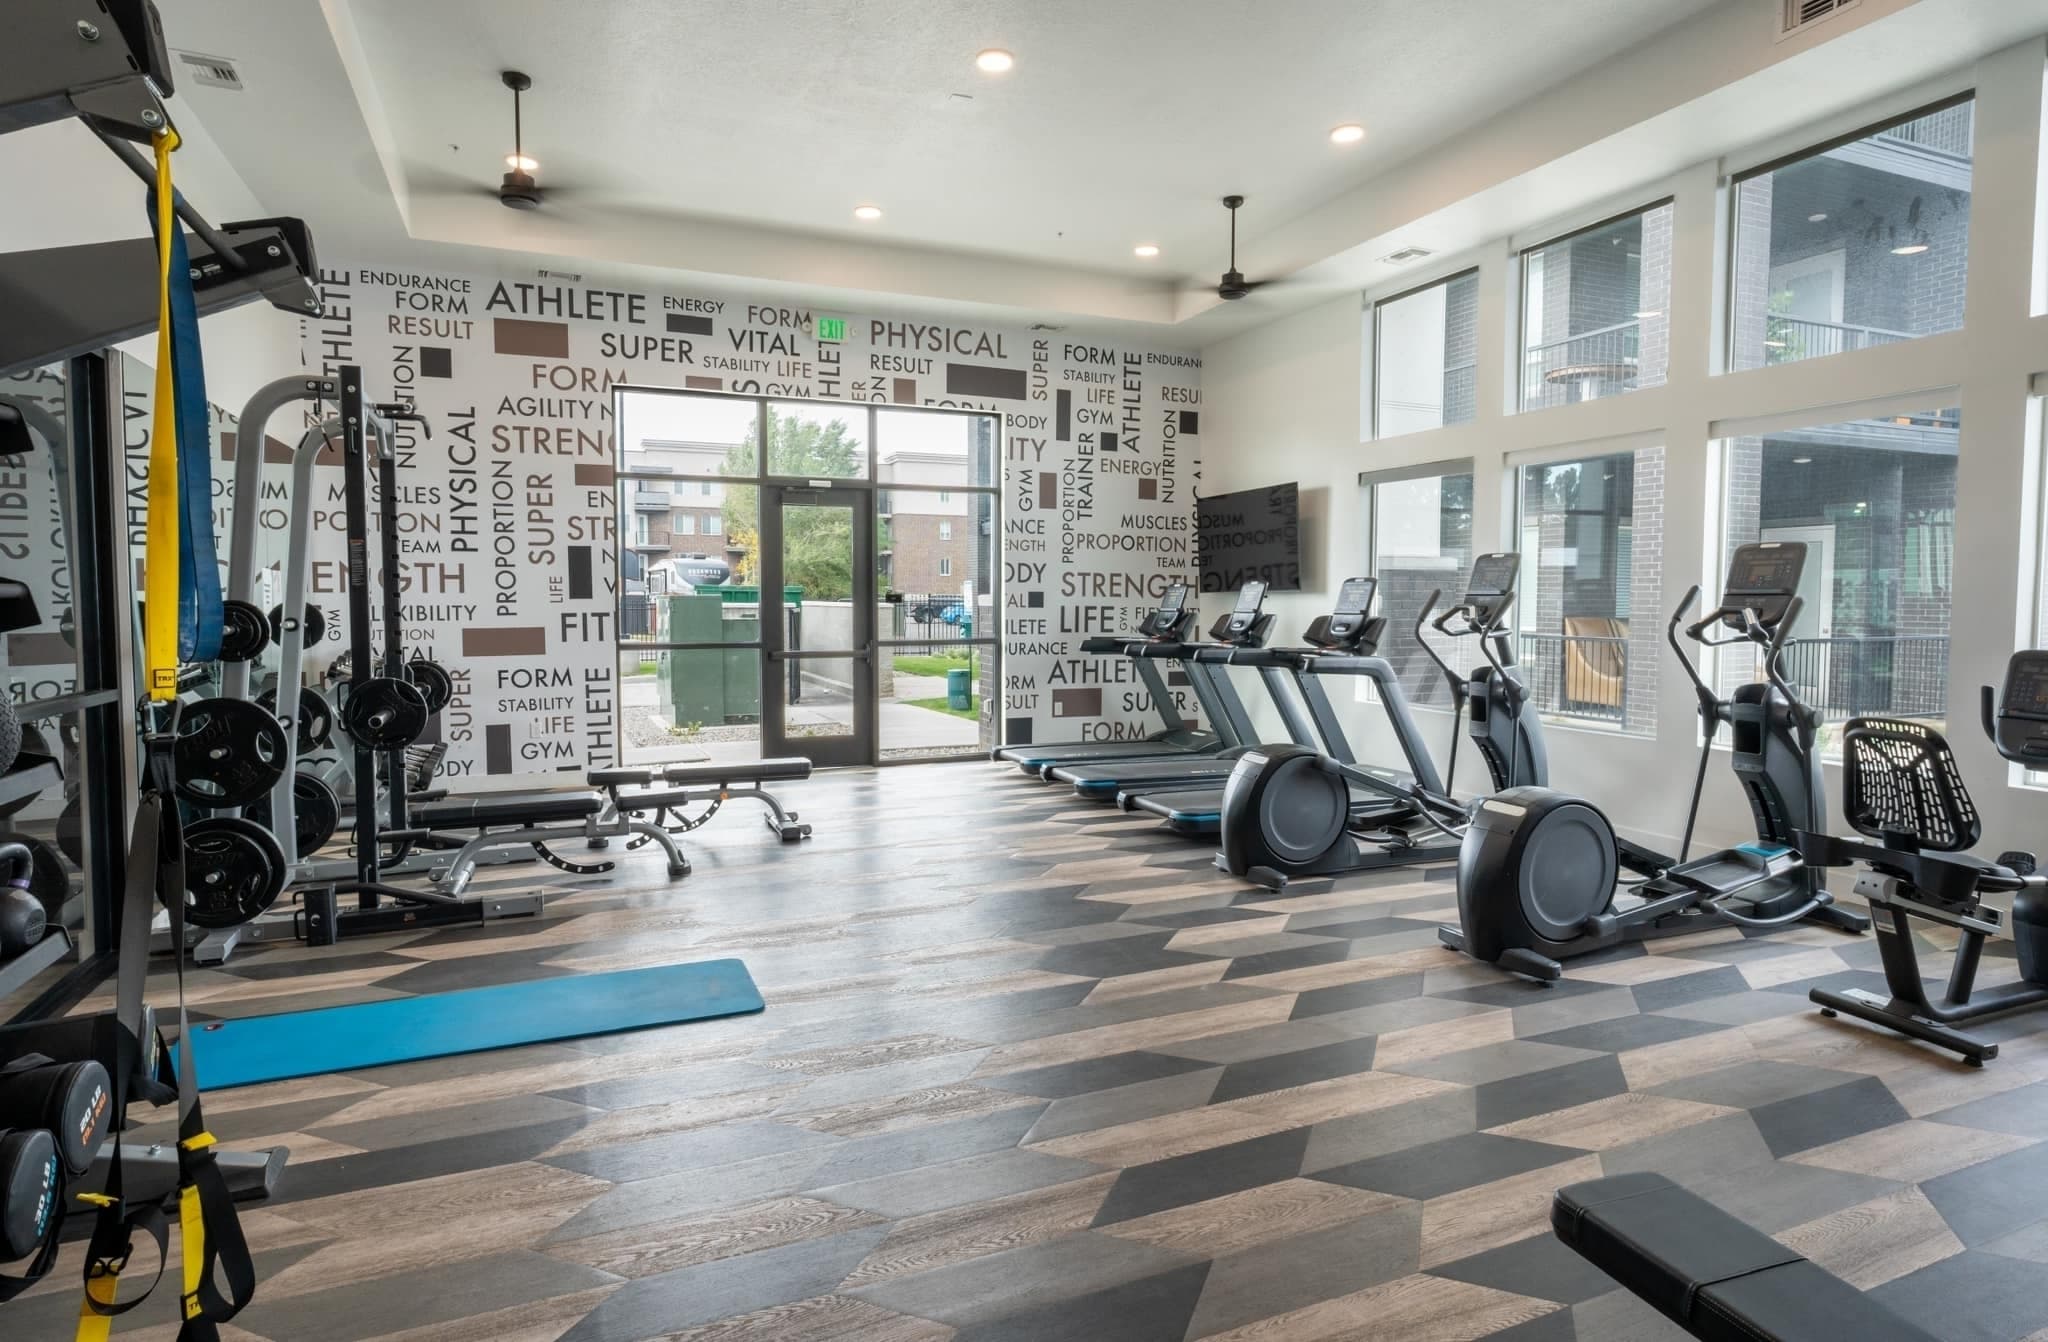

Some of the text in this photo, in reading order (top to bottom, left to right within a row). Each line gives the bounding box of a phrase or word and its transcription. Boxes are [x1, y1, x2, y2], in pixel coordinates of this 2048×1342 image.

[360, 270, 471, 293] ENDURANCE
[396, 291, 468, 314] FORM
[485, 279, 646, 324] ATHLETE
[664, 296, 724, 314] ENERGY
[320, 269, 352, 377] THLETE
[388, 315, 474, 339] RESULT
[748, 305, 812, 328] FORM
[819, 319, 845, 340] EXIT
[871, 320, 1007, 358] PHYSICAL
[601, 333, 694, 364] SUPER
[728, 328, 801, 356] VITAL
[704, 356, 770, 372] STABILITY
[870, 354, 933, 374] RESULT
[1065, 344, 1115, 366] FORM
[533, 364, 626, 392] FORM
[778, 360, 811, 378] LIFE
[1032, 340, 1048, 400] SUPER
[1064, 369, 1116, 384] STABILITY
[393, 346, 416, 468] NUTTION
[497, 396, 593, 419] AGILITY
[1087, 388, 1115, 404] LIFE
[1122, 352, 1142, 453] ATHLETE
[1007, 414, 1047, 430] BODY
[1077, 409, 1113, 425] GYM
[492, 425, 613, 456] STREN
[1101, 458, 1161, 475] ENERGY
[1162, 410, 1176, 503] NUTRITION
[448, 407, 478, 552] PHYSICAL
[1077, 433, 1094, 520] TRAINER
[1019, 470, 1032, 511] GYM
[526, 474, 555, 565] SUPER
[1062, 459, 1075, 563] PROPORTION
[1121, 515, 1187, 531] MUSCLES
[399, 540, 440, 552] EAM
[491, 461, 517, 616] PROPORTION
[1077, 534, 1186, 552] PROPORTION
[1157, 557, 1185, 568] TEAM
[549, 576, 563, 603] LIFE
[328, 610, 341, 641] GYM
[1060, 606, 1114, 633] LIFE
[1120, 607, 1128, 630] GYM
[1005, 641, 1069, 657] URANCE
[498, 668, 572, 688] FORM
[1048, 659, 1136, 684] ATHLET
[451, 669, 472, 741] SUPER
[498, 697, 573, 712] STABILITY
[541, 716, 575, 734] IFE
[1082, 722, 1146, 742] FORM
[521, 741, 573, 759] GYM
